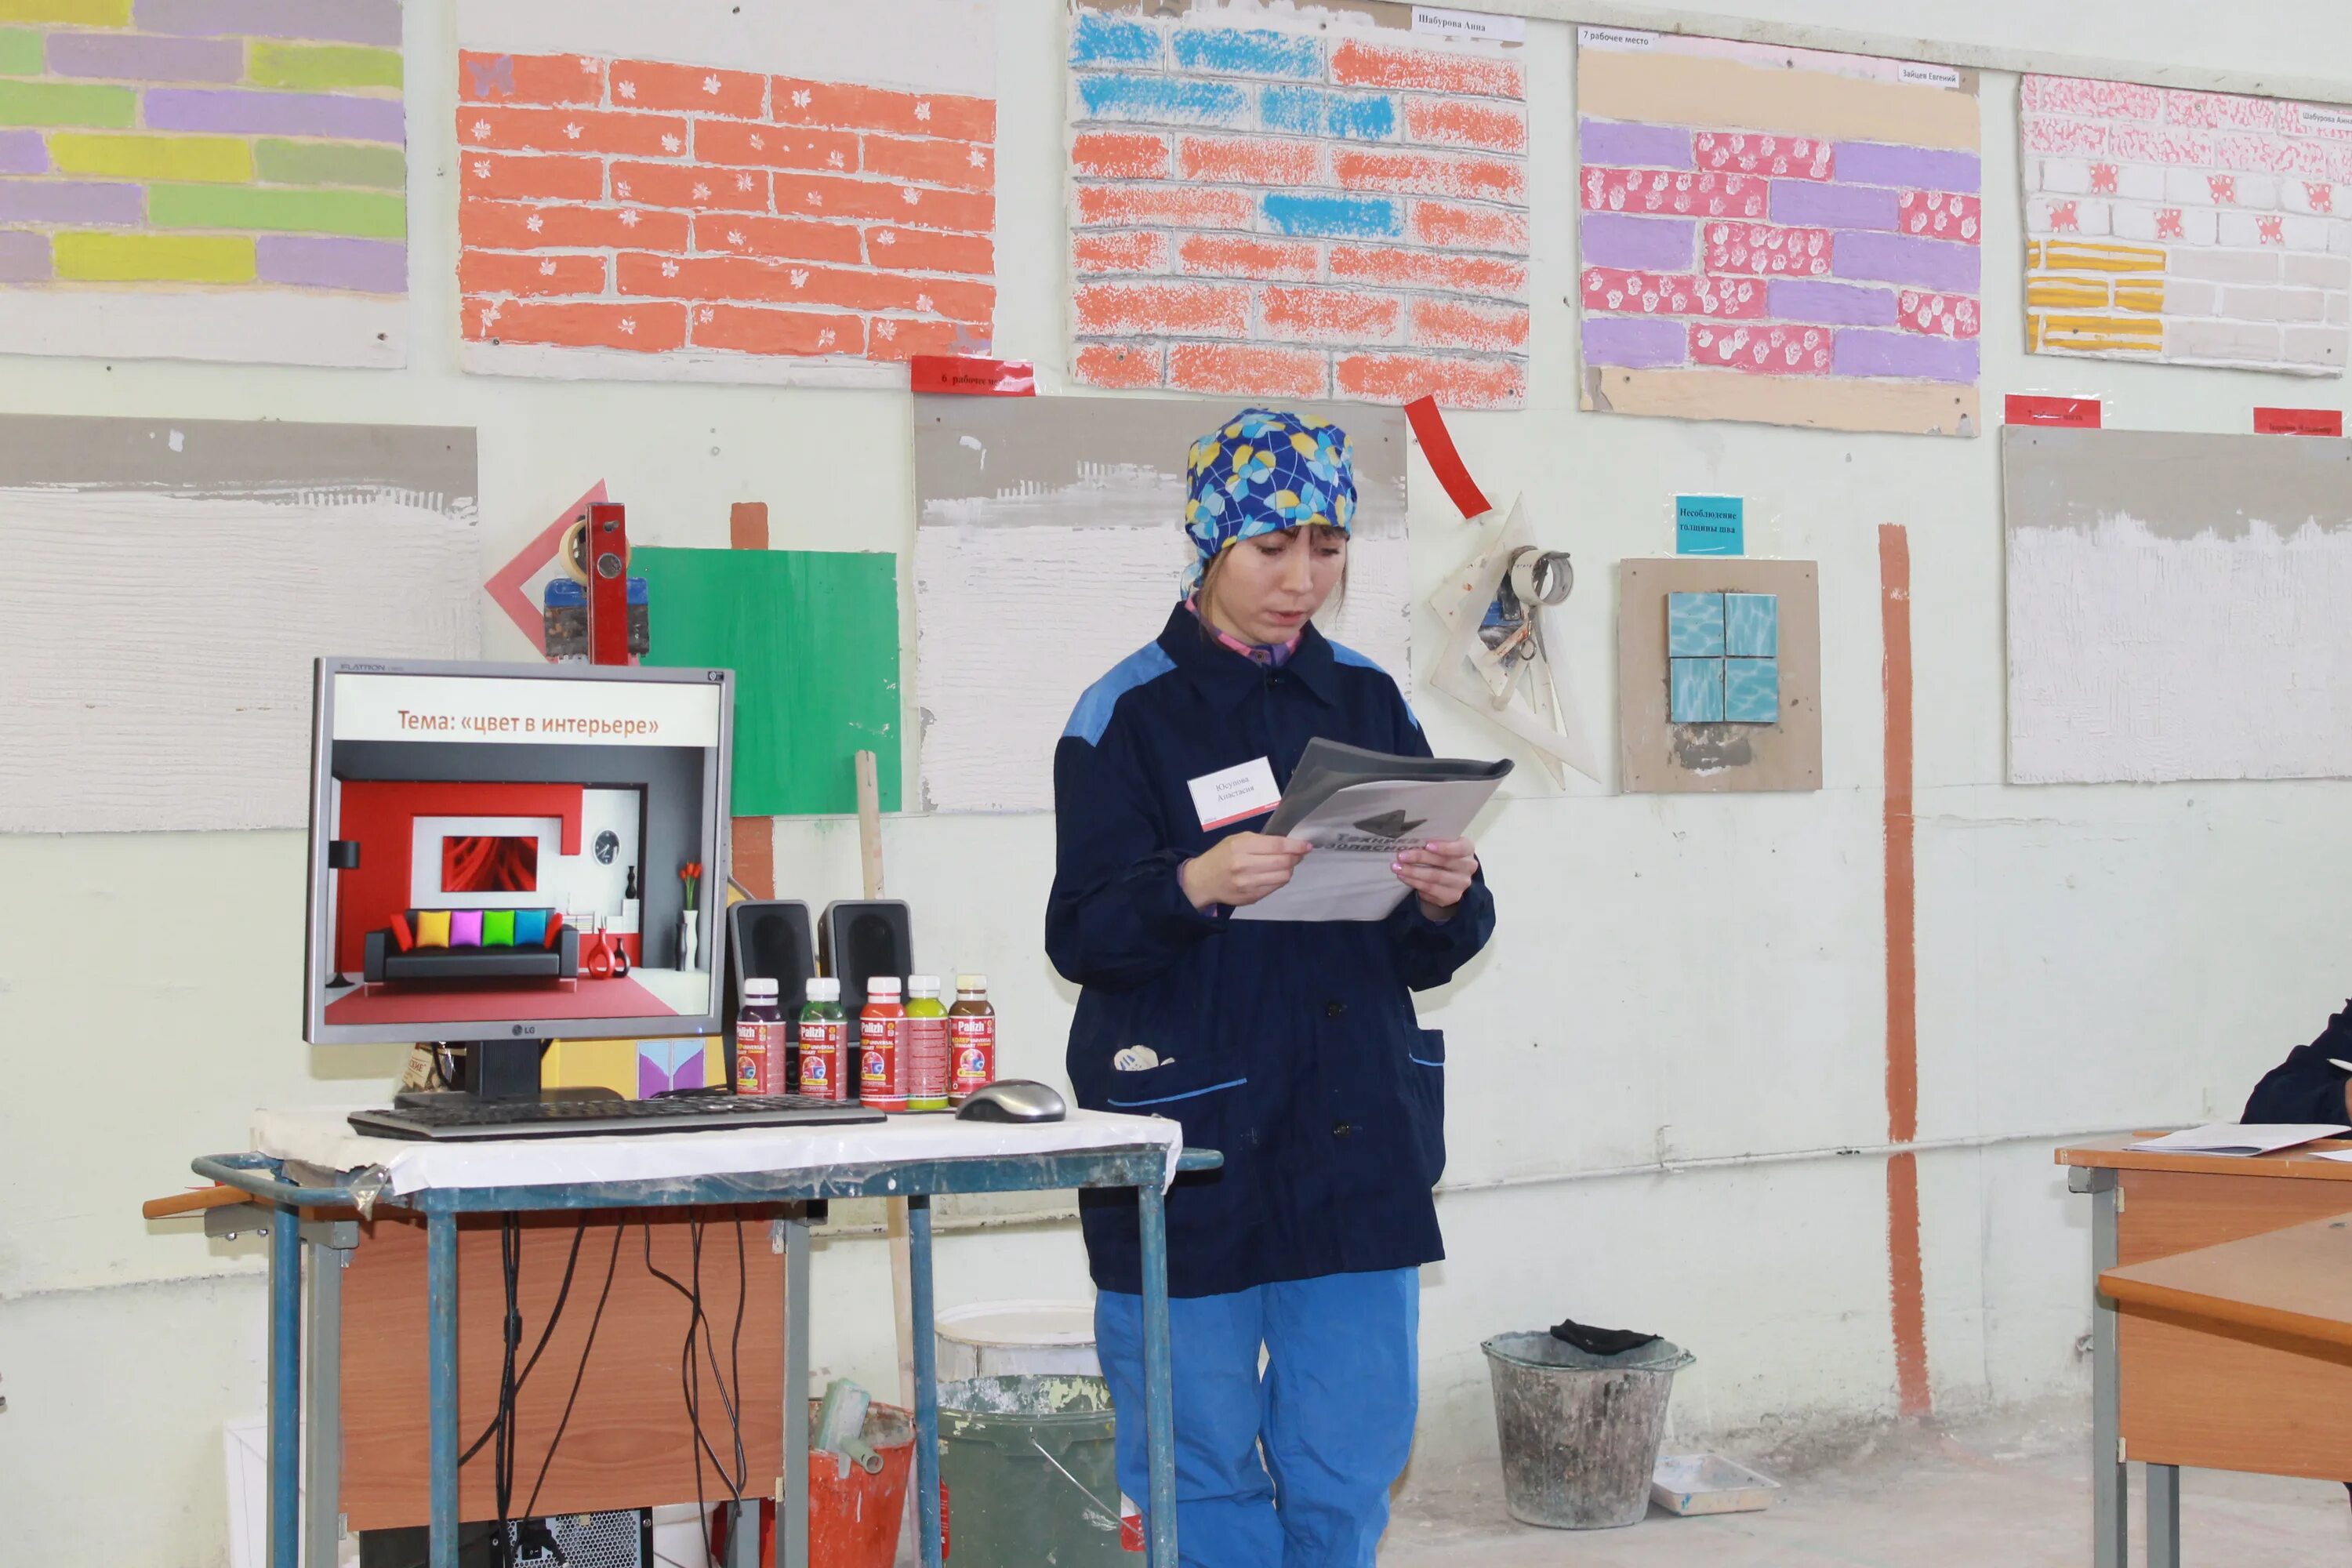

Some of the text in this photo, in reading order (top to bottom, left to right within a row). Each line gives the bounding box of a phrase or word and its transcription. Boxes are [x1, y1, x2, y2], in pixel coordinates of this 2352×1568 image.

[1418, 14, 1486, 32] Шабурова Анна
[1590, 31, 1623, 42] рабочее
[1624, 36, 1649, 45] место
[1903, 69, 1956, 82] Зайцев Евгений
[2303, 112, 2335, 123] Шабурова
[942, 374, 947, 383] 6
[953, 375, 985, 386] рабочее
[1680, 508, 1737, 519] Несоблюдение
[397, 710, 659, 739] Тема: «цвет в интерьере»
[1216, 777, 1249, 792] Юсупова
[1218, 786, 1254, 802] Анастасия
[800, 1026, 826, 1038] Palizh
[861, 1022, 884, 1034] Palizh
[958, 1021, 984, 1033] Palizh
